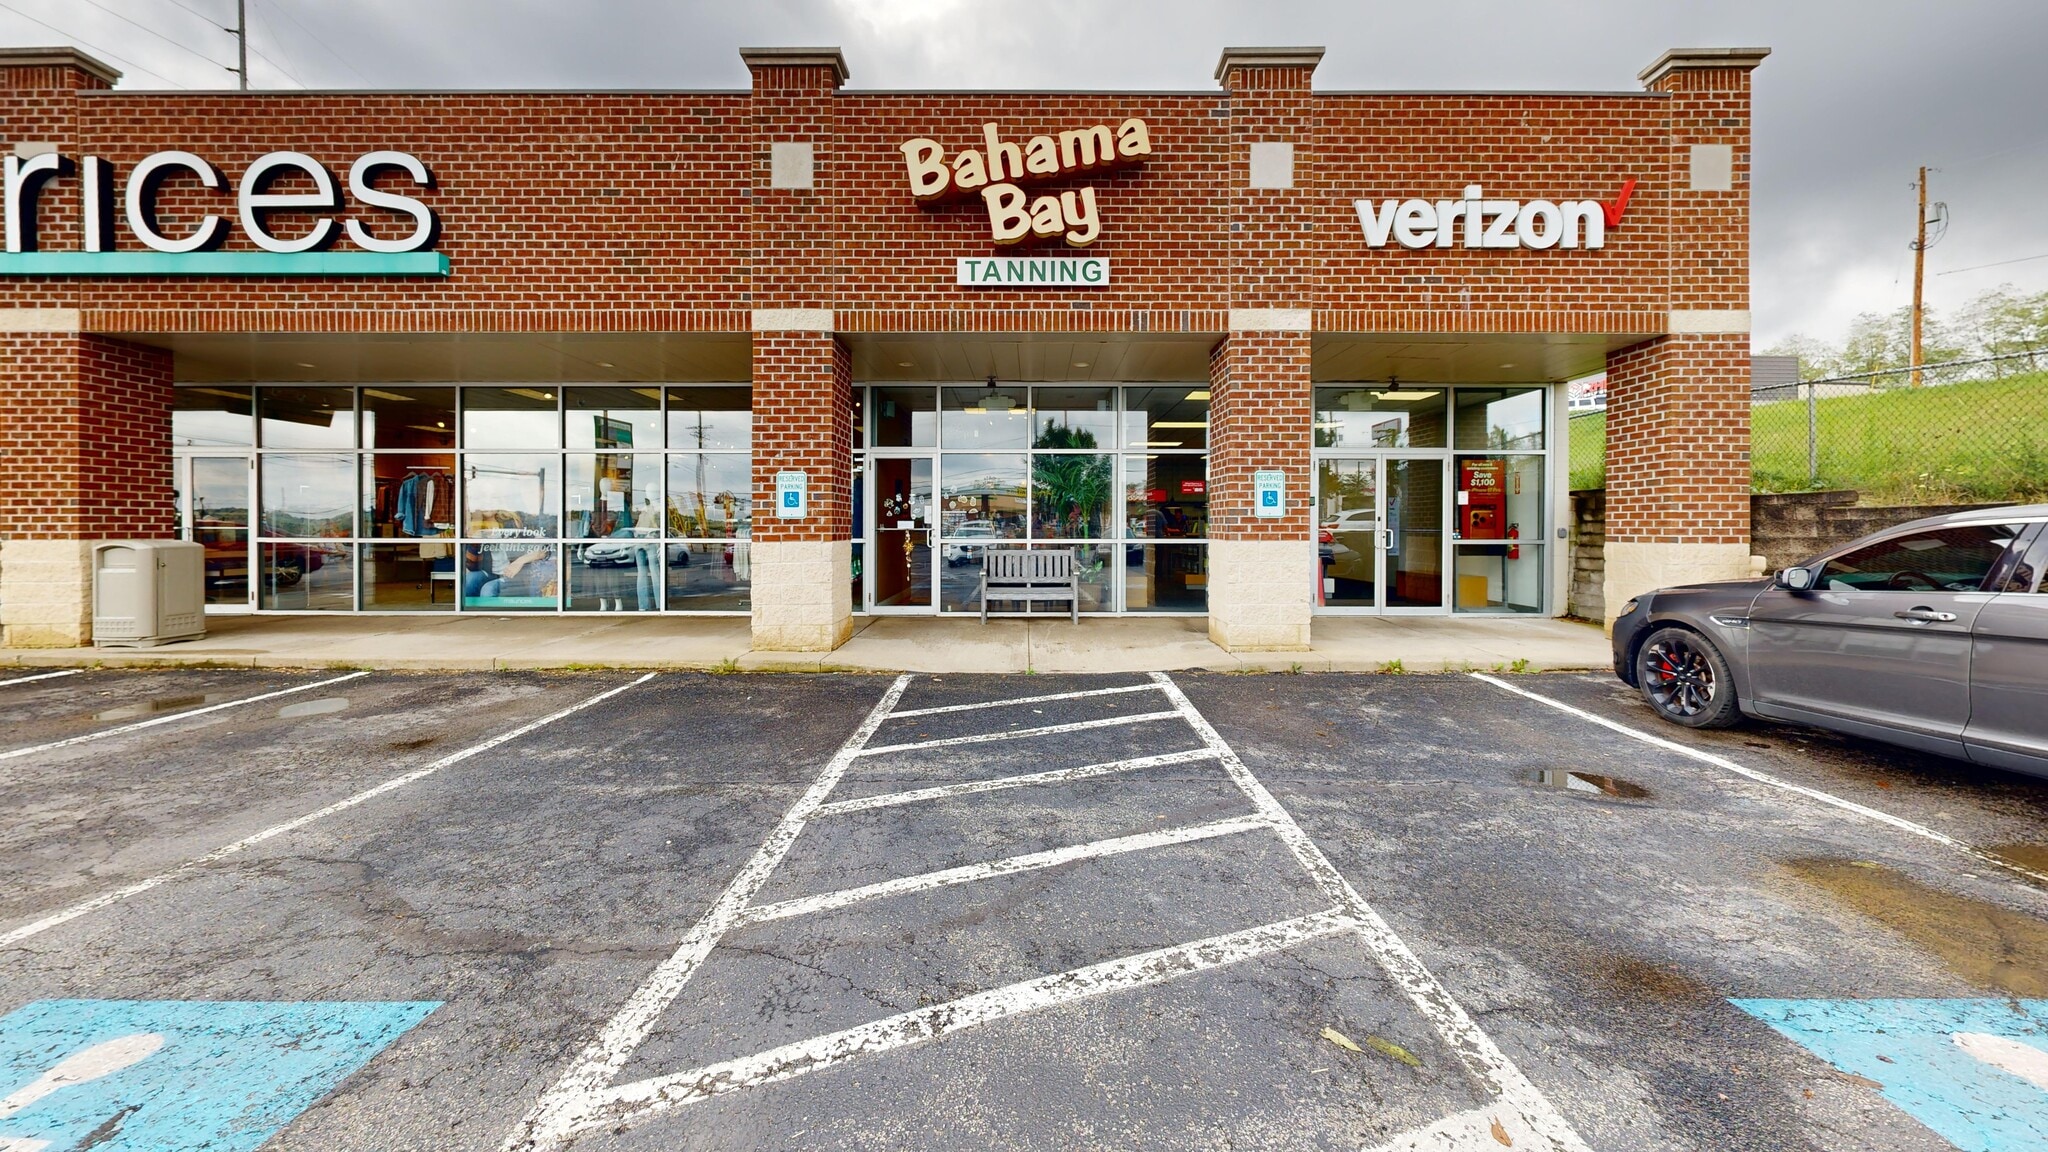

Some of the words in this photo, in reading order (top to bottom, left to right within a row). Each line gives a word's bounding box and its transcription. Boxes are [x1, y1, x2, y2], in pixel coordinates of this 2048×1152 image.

[899, 118, 1152, 198] Bahama
[4, 150, 434, 253] rices
[981, 183, 1101, 245] Bay
[1354, 184, 1605, 250] verizon
[965, 260, 1102, 283] TANNING
[1470, 478, 1495, 487] $1,100
[1473, 471, 1492, 479] Save
[490, 527, 520, 538] Every
[522, 526, 547, 537] look
[527, 543, 557, 554] good.
